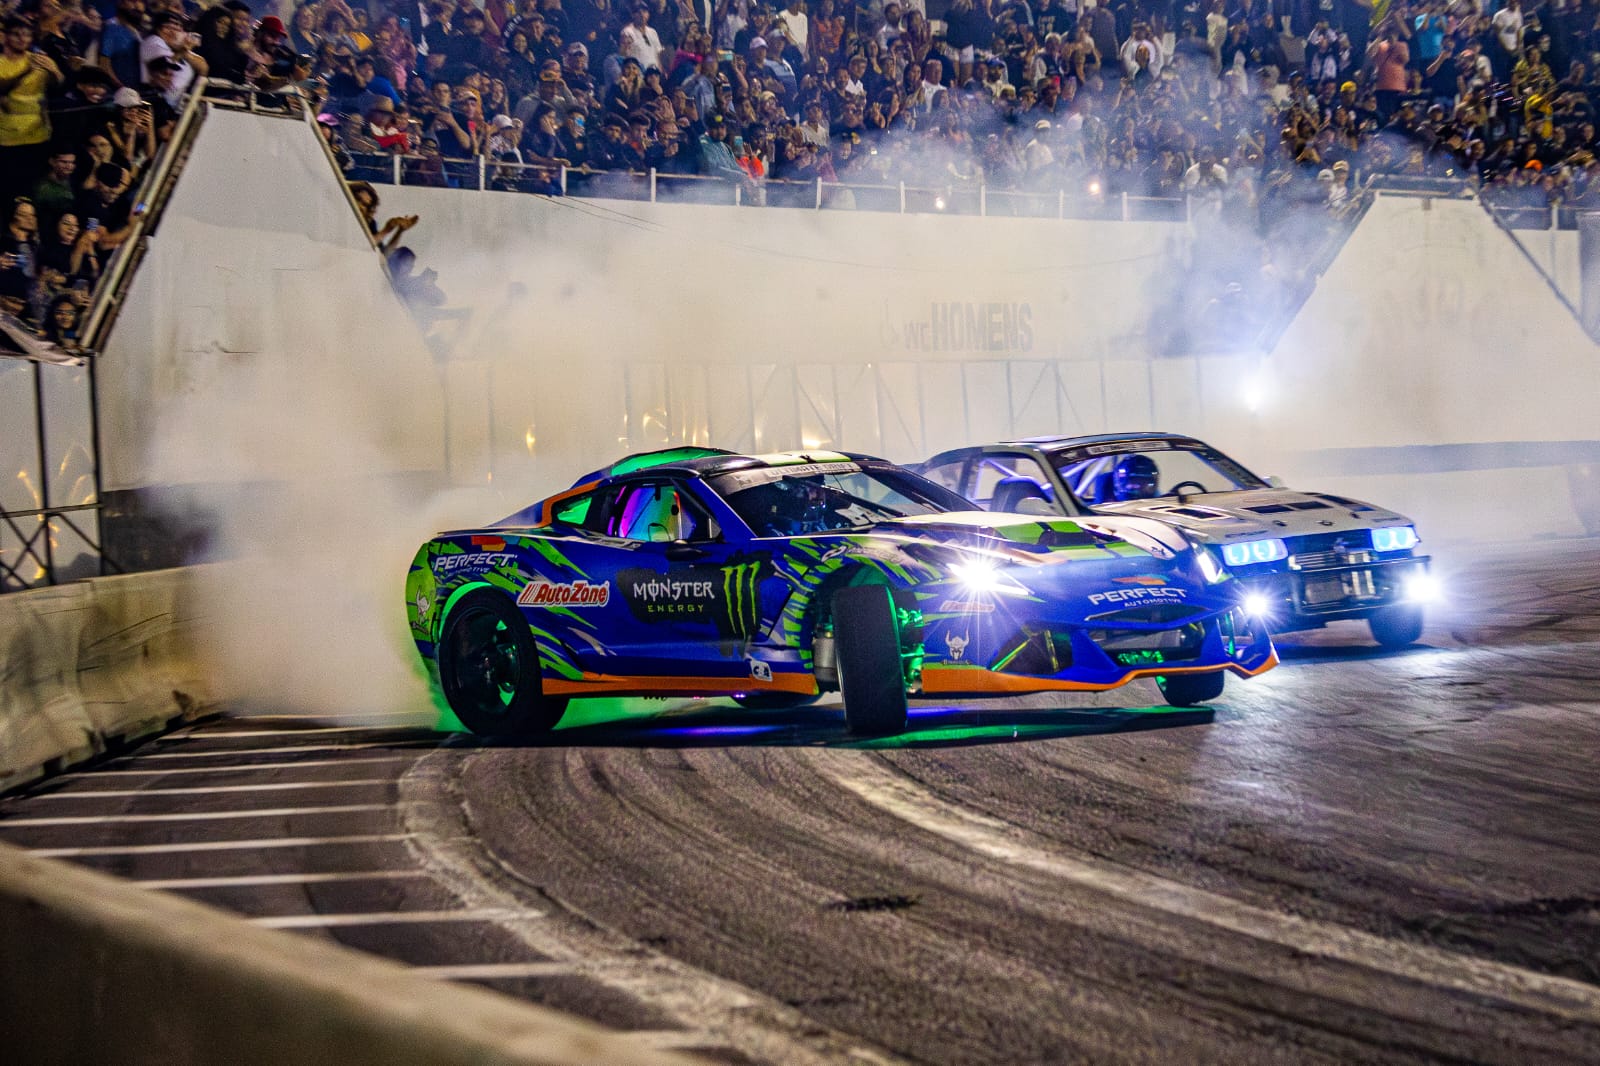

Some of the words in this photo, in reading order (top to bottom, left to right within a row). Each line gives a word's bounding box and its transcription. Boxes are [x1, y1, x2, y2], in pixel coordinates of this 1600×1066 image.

[931, 302, 1033, 352] HOMENS
[434, 552, 514, 572] PERFECT
[534, 582, 608, 604] AutoZone
[633, 578, 715, 601] MONSTER
[1087, 588, 1187, 605] PERFECT
[647, 604, 704, 612] ENERGY
[1124, 599, 1182, 607] AUTOMOTIVE
